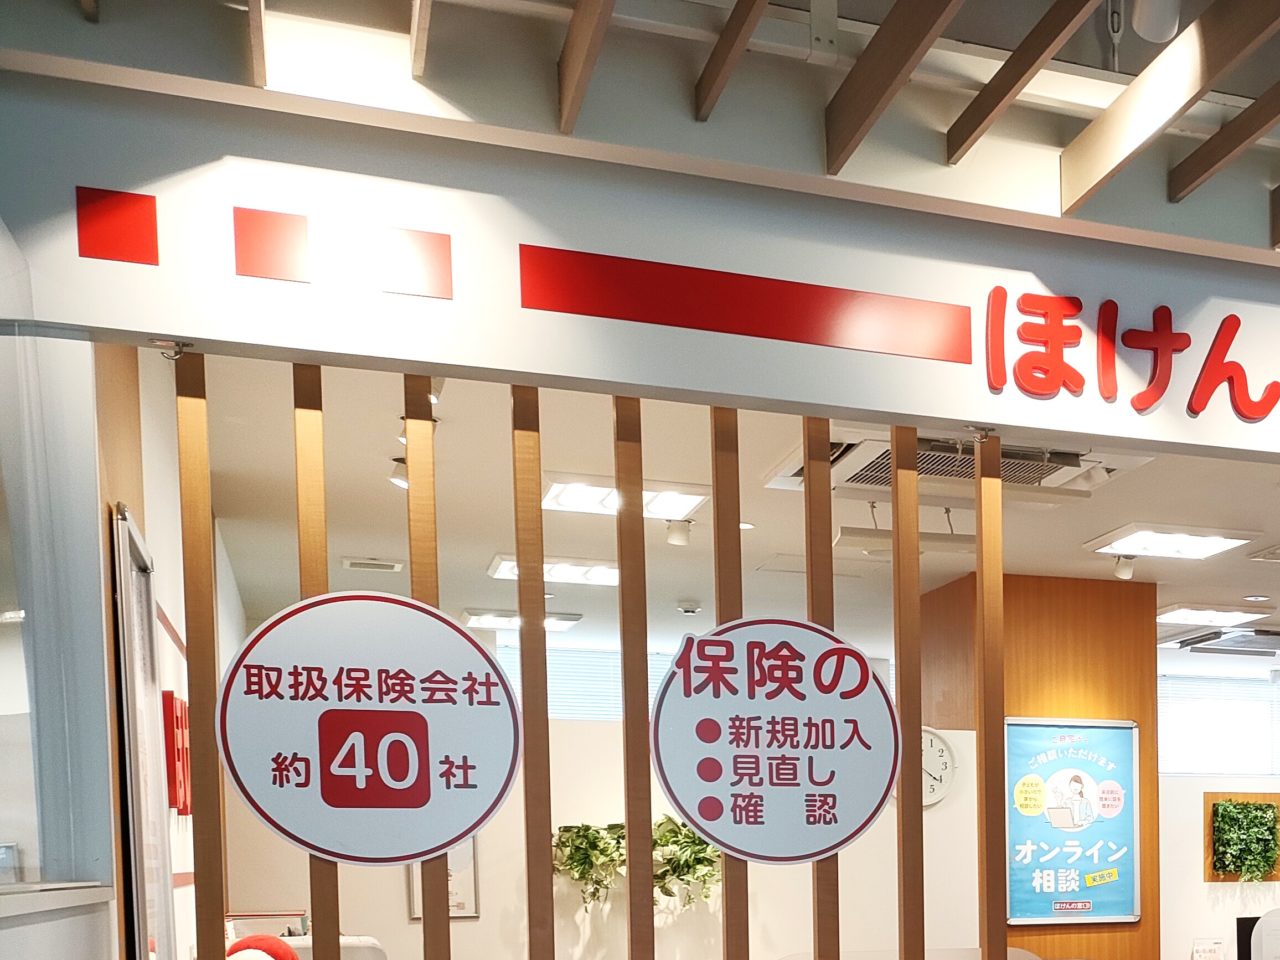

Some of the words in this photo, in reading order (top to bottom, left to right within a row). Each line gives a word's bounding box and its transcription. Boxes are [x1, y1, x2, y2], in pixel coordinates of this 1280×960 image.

[675, 637, 869, 701] 保険の
[243, 664, 500, 706] 取扱保険会社
[728, 715, 872, 750] 新規加入
[938, 748, 944, 757] 2
[730, 754, 836, 787] 見直し
[941, 761, 948, 771] 3
[929, 784, 935, 793] 5
[1015, 840, 1128, 864] オンライン
[1032, 868, 1080, 893] 相談
